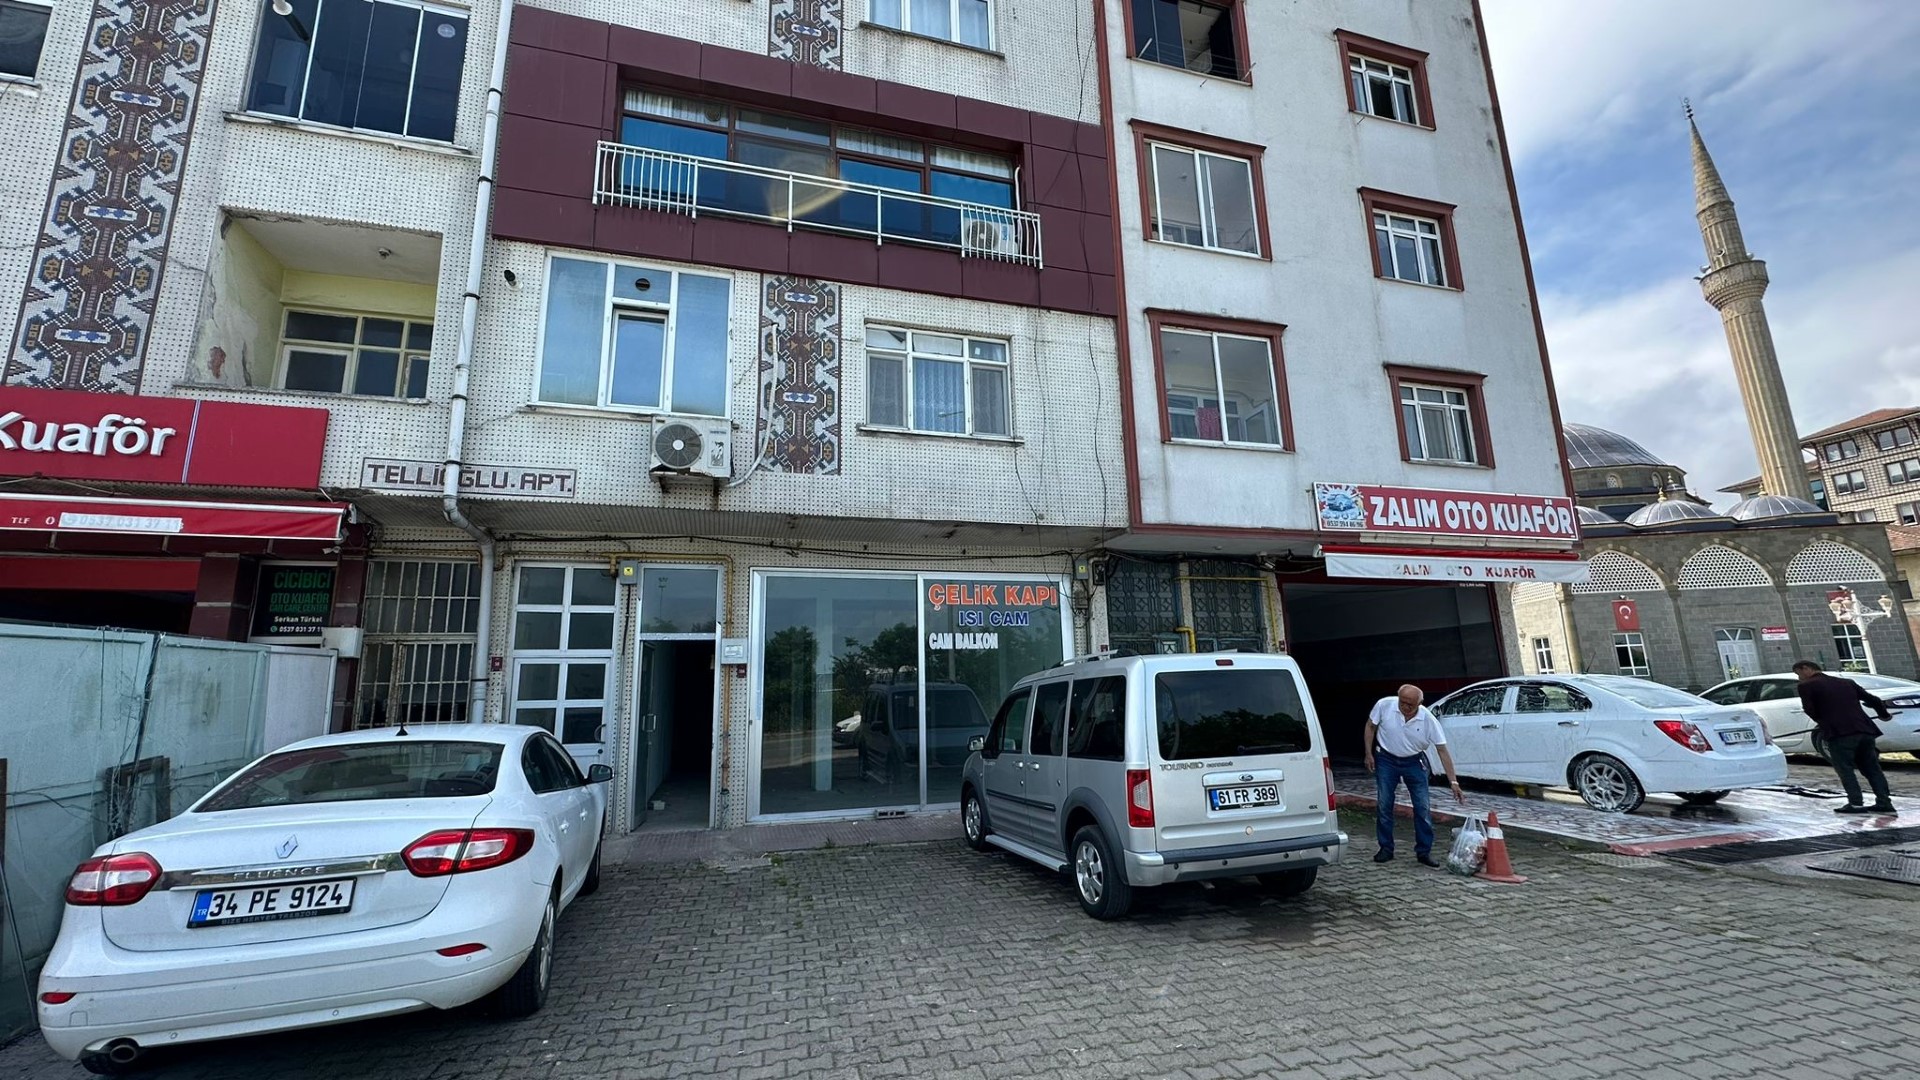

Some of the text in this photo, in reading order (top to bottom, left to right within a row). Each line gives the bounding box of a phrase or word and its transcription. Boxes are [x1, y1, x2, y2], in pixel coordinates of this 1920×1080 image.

[11, 516, 31, 525] TLF
[1370, 496, 1574, 535] ZALIM OTO KUAFÖR
[1485, 565, 1536, 579] KUAFÖR
[271, 590, 330, 603] OTO KUAFÖR
[1004, 585, 1057, 606] KAPI
[300, 615, 323, 623] Türkel
[959, 610, 1029, 627] ISI CAM
[928, 632, 998, 650] CAM BALKON
[1159, 761, 1204, 772] TOURNEO
[1218, 787, 1276, 804] 61 FR 389
[233, 866, 326, 881] FLUENCE
[209, 883, 343, 918] 34 PE 9124
[197, 908, 207, 916] TR
